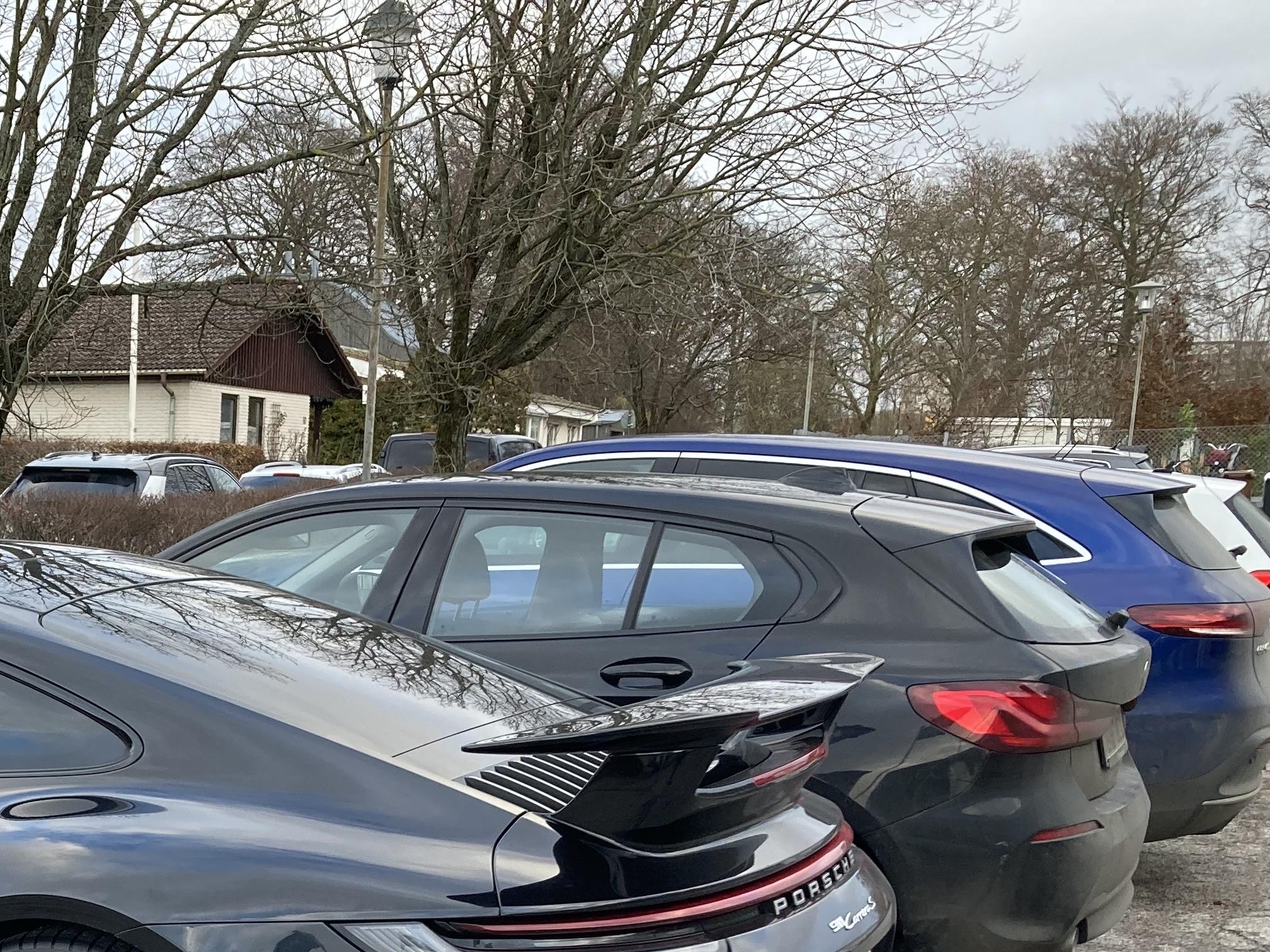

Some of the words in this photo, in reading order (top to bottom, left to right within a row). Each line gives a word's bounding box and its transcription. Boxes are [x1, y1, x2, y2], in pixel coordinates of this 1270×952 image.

[773, 849, 855, 916] PORSCHE
[828, 915, 846, 933] 911
[845, 904, 871, 930] Carrera
